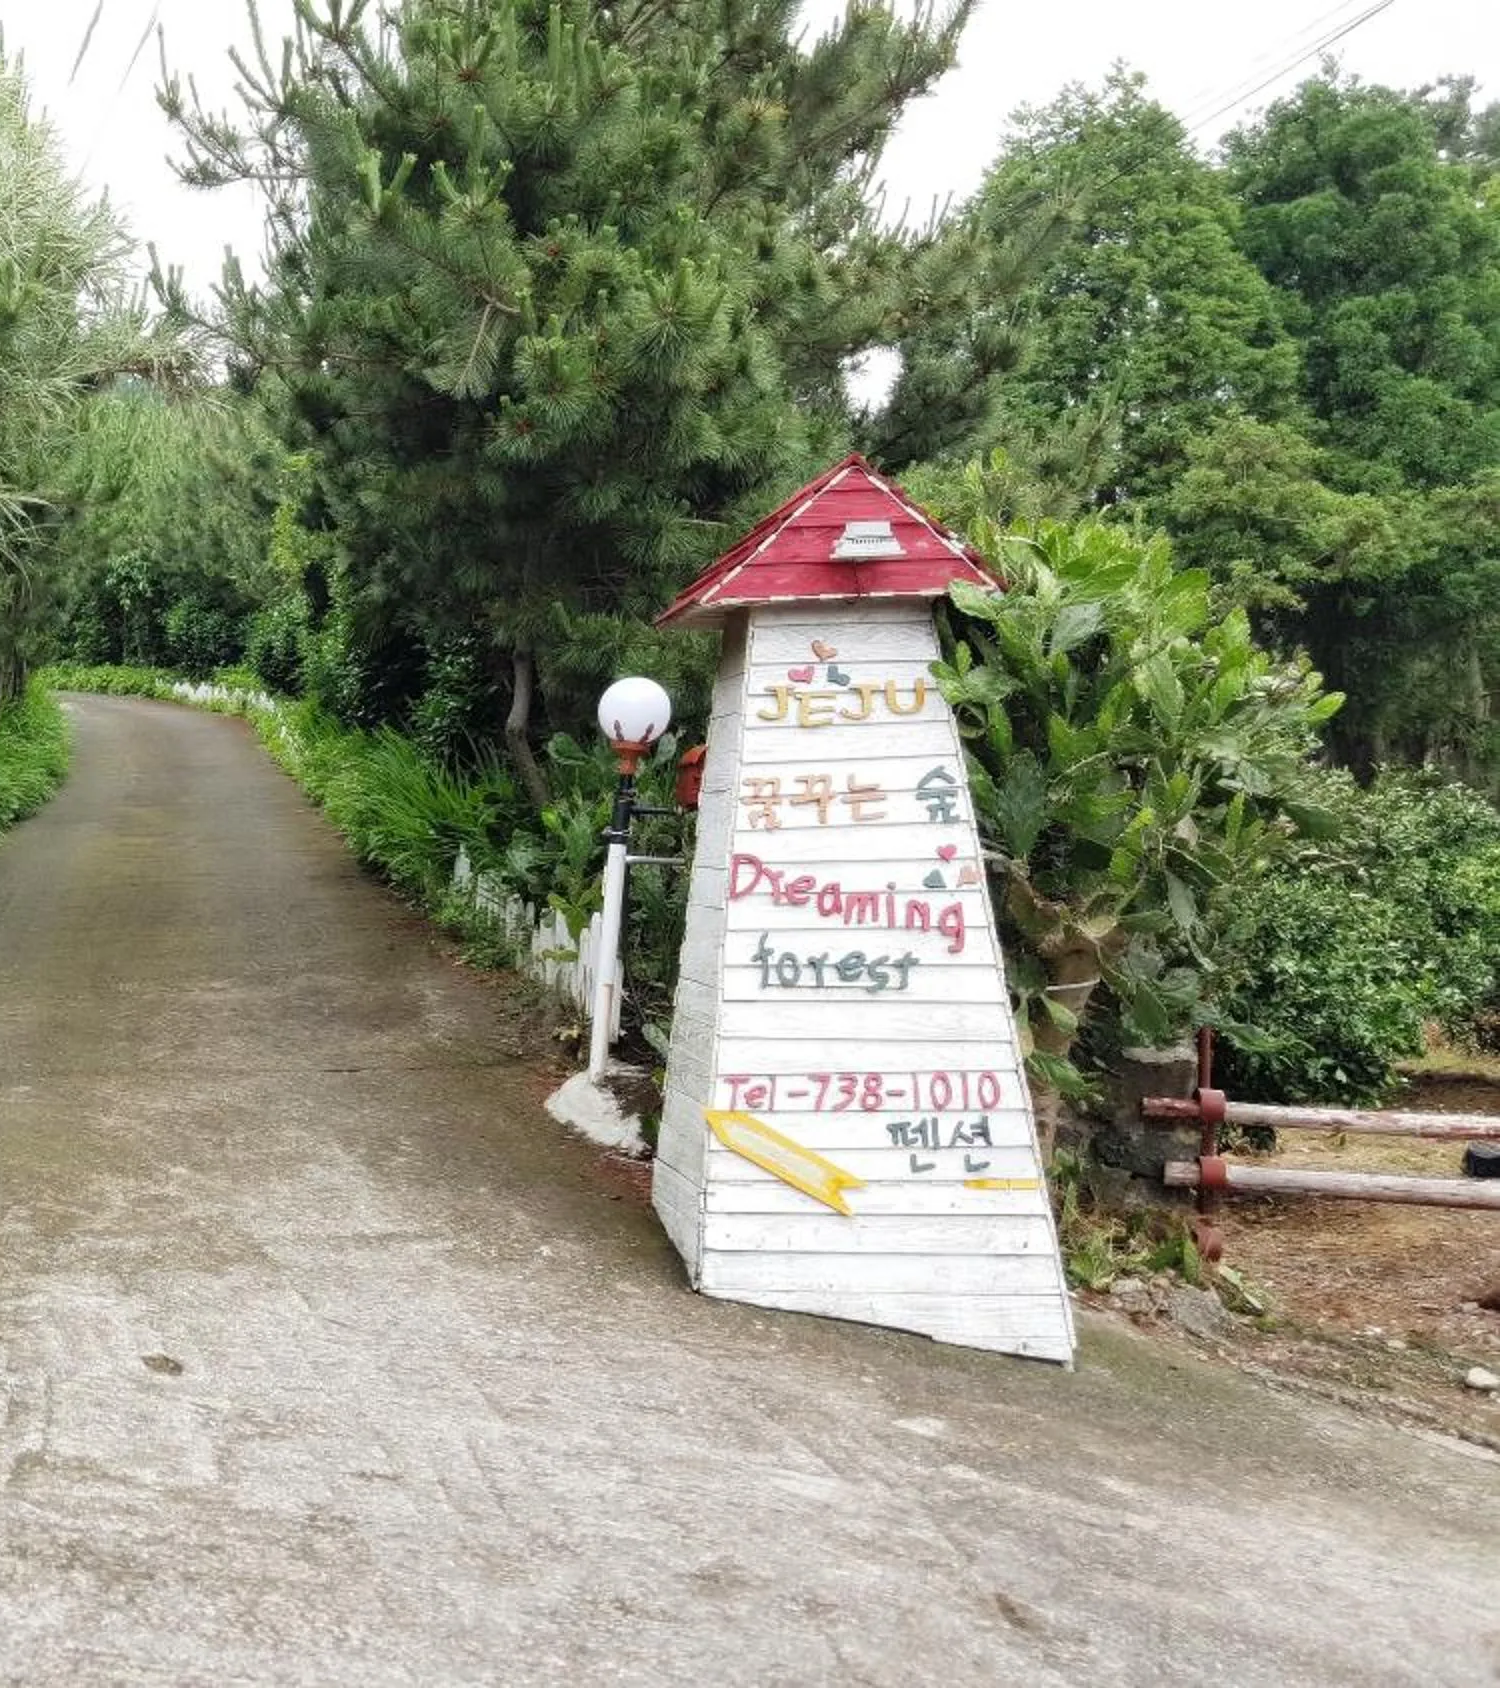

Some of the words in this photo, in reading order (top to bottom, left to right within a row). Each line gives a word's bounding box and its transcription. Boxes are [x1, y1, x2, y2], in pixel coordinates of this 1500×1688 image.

[756, 677, 926, 728] JEJU
[915, 765, 961, 824] 숲
[728, 853, 966, 953] Dreaming
[885, 1115, 994, 1173] 펜션
